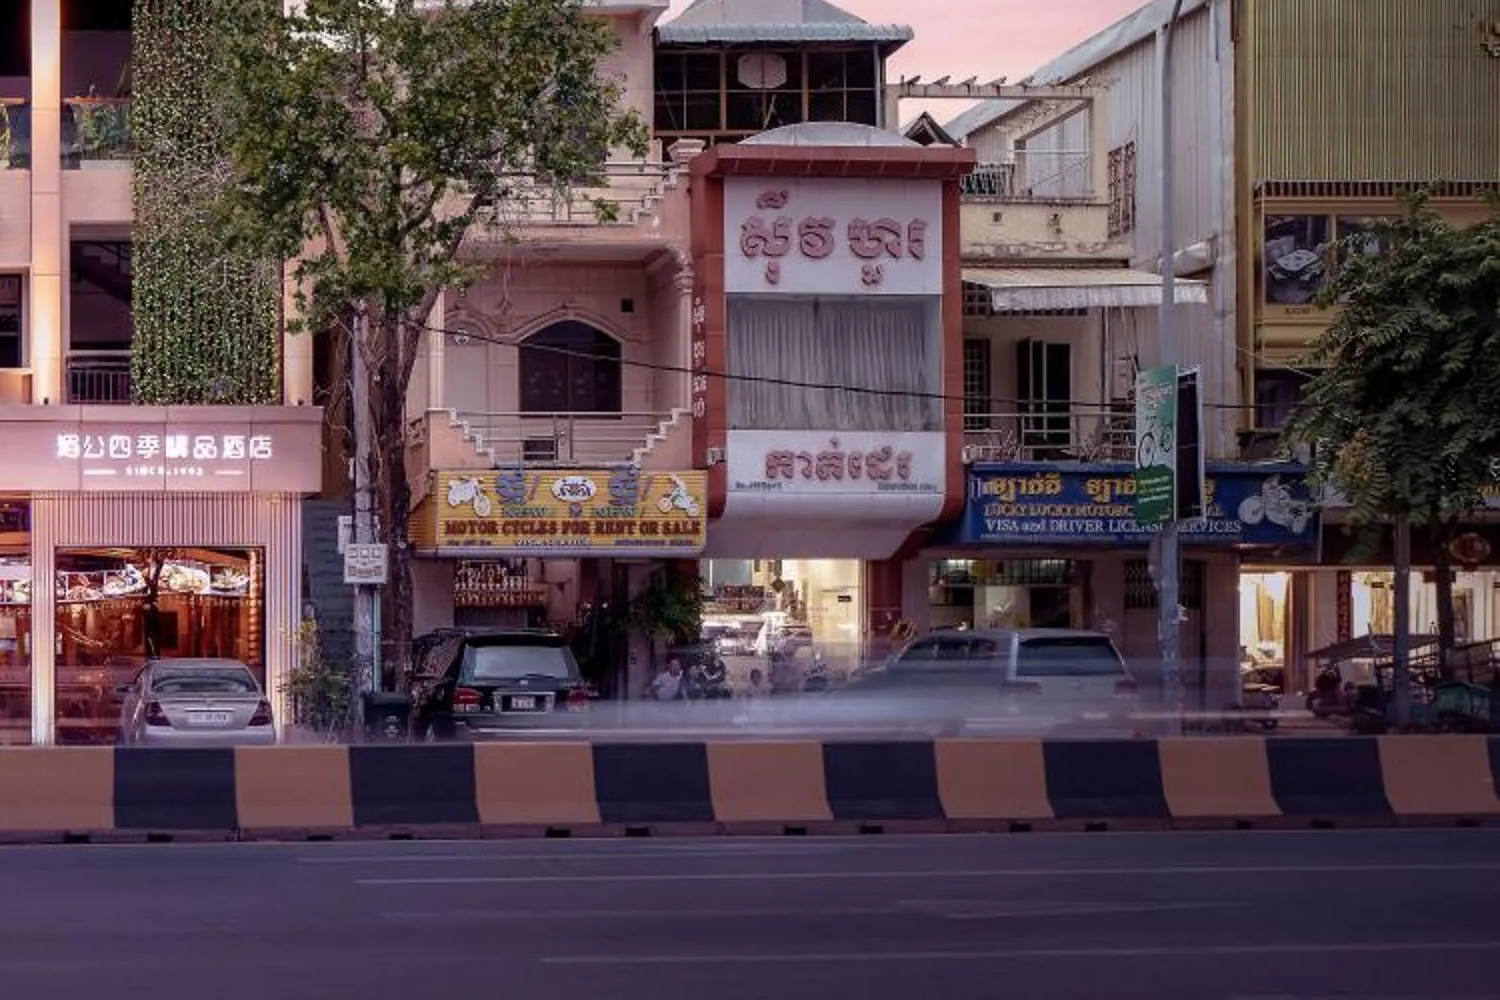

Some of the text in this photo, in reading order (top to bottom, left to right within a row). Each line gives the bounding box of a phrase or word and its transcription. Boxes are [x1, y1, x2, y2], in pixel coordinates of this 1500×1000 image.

[445, 520, 700, 536] MOTOR CYCLES FOR RENT OR SALE
[986, 519, 1019, 532] VISA
[1022, 519, 1045, 532] and
[1050, 519, 1103, 532] DRIVER
